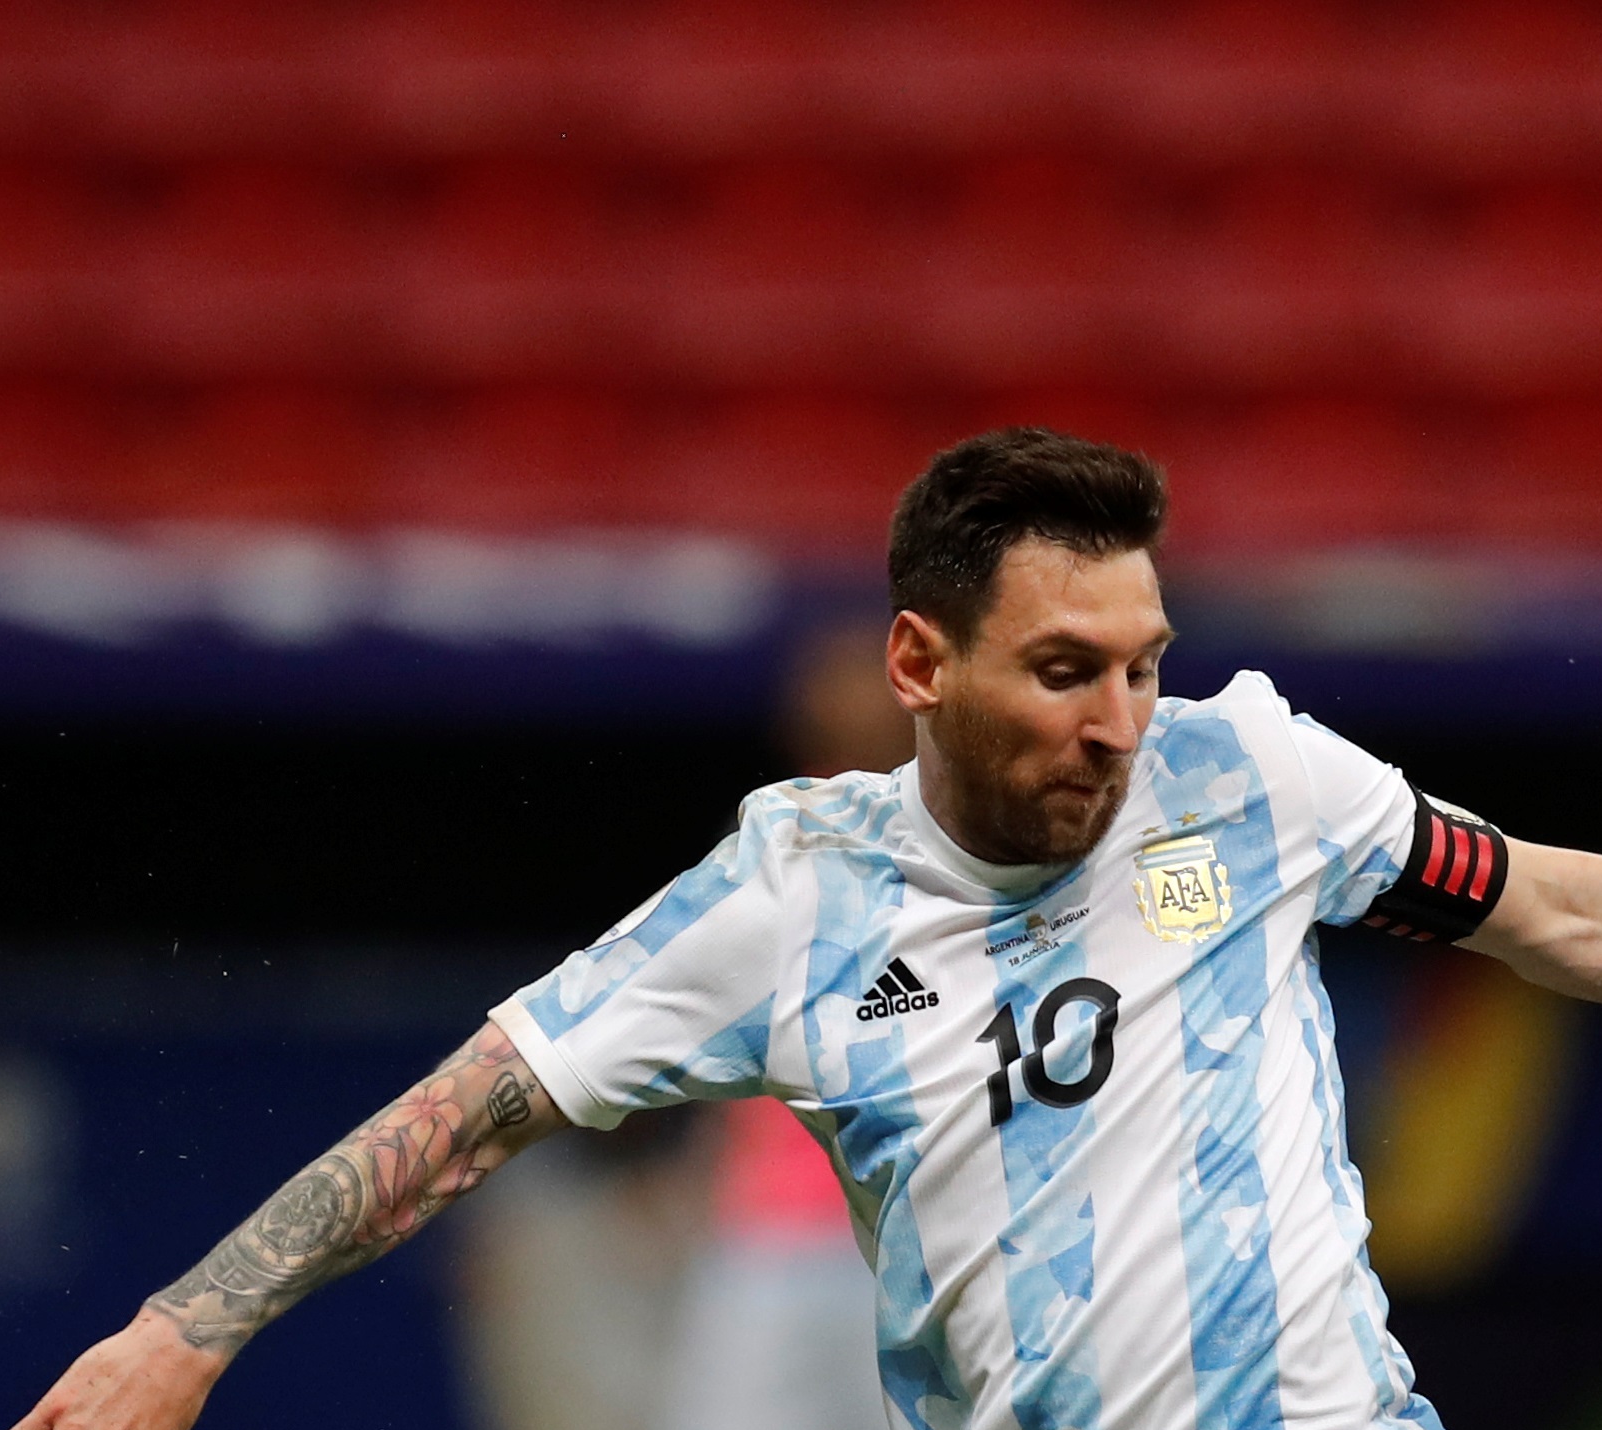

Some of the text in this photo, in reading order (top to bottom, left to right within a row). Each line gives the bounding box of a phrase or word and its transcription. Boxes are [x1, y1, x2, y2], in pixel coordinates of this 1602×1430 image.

[1160, 866, 1211, 914] AFA
[985, 933, 1029, 956] ARGENTINA
[1049, 907, 1090, 931] URUGUAY
[856, 990, 940, 1022] adidas
[975, 977, 1122, 1127] 10
